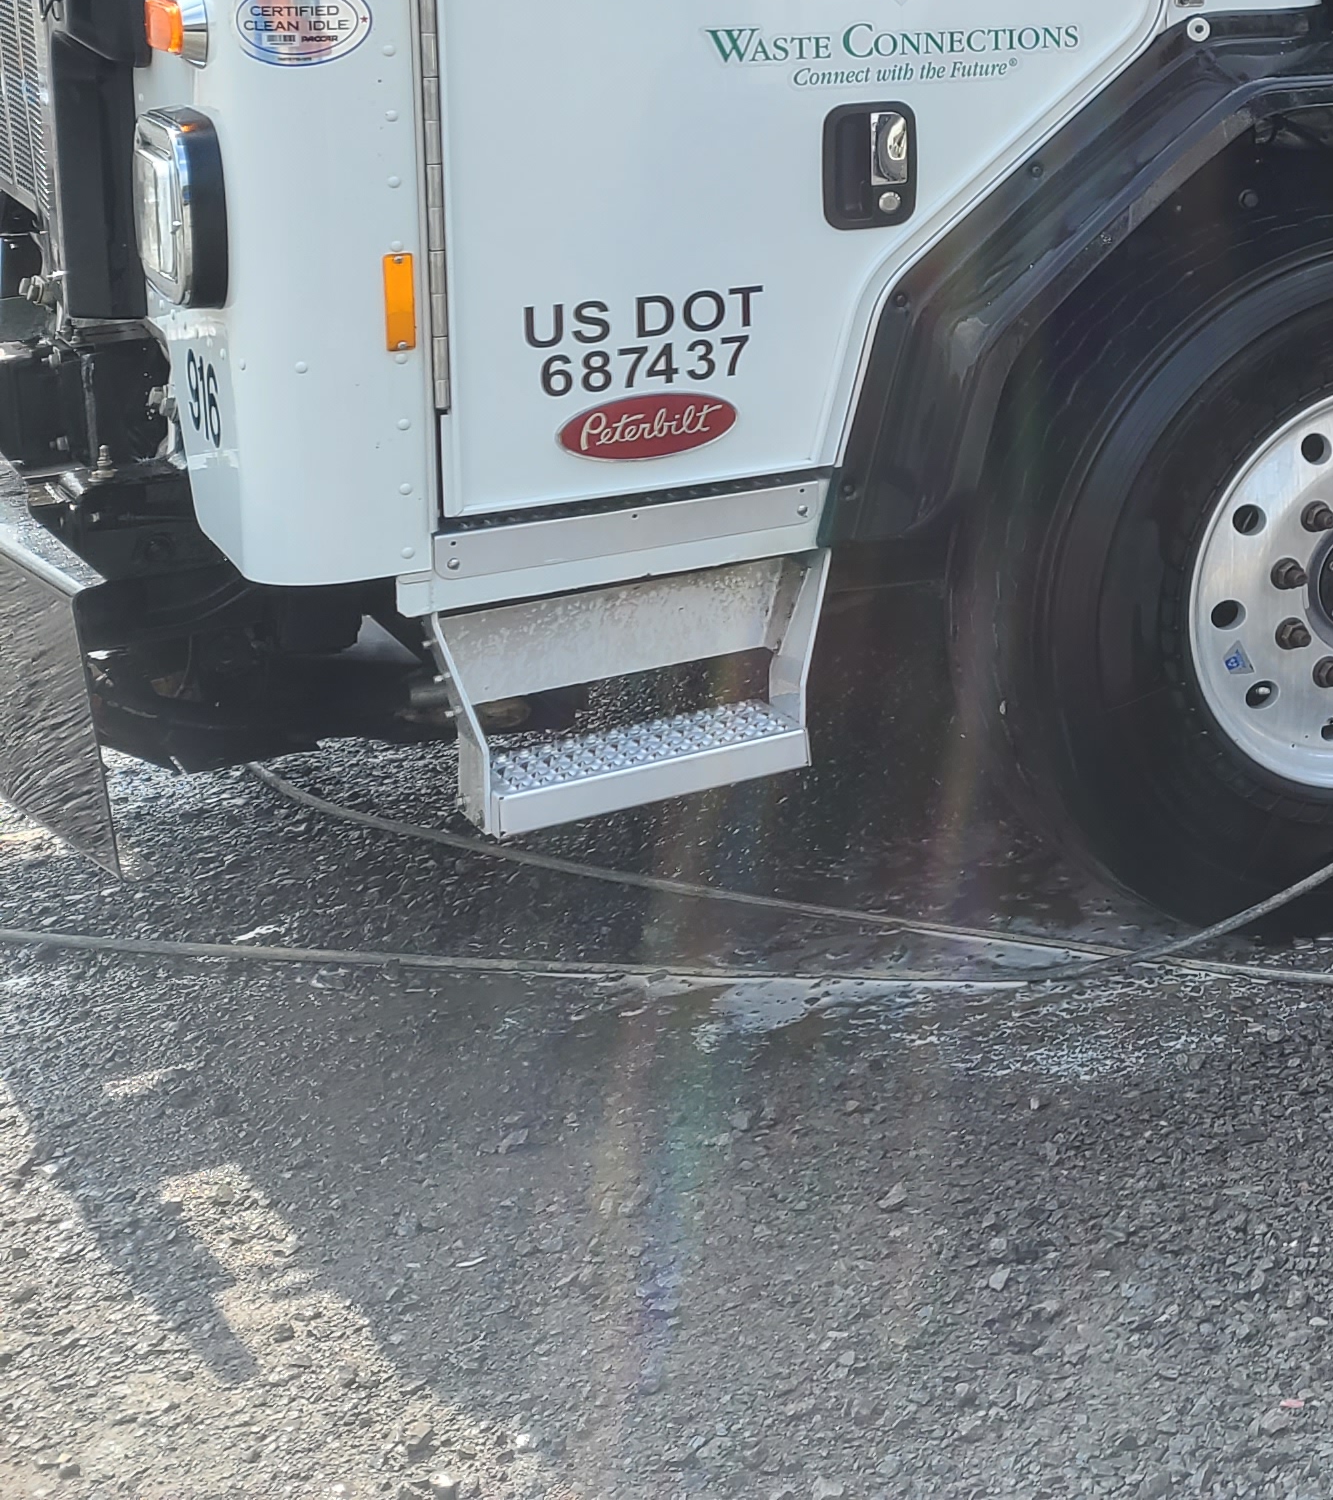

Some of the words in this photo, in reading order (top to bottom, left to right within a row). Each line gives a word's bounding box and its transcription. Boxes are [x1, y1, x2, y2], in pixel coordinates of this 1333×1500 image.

[243, 19, 299, 32] CLEAN
[308, 19, 351, 31] IDLE
[249, 5, 340, 17] CERTIFIED
[300, 34, 339, 43] PACCAR
[705, 28, 832, 63] WASTE
[842, 23, 1080, 58] CONNECTIONS
[793, 65, 871, 86] Connect
[876, 62, 914, 82] with
[919, 60, 946, 80] the
[523, 300, 611, 348] US
[635, 285, 764, 338] DOT
[540, 334, 750, 397] 687437
[187, 348, 220, 449] 916
[579, 404, 724, 451] Peterbilt
